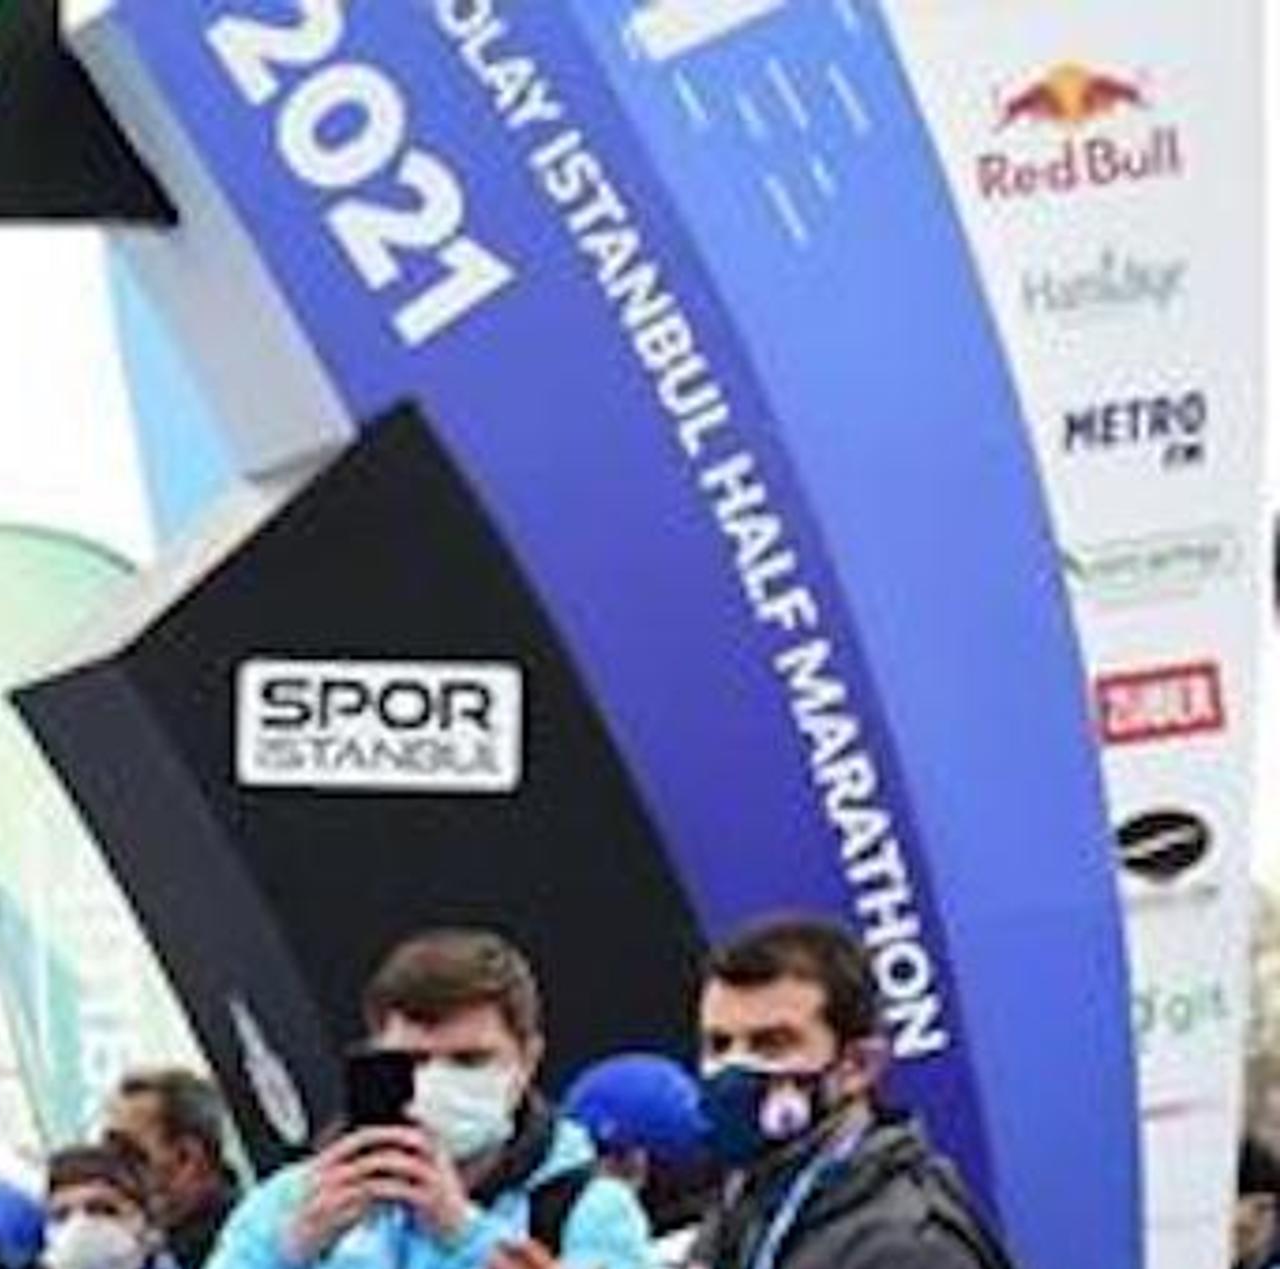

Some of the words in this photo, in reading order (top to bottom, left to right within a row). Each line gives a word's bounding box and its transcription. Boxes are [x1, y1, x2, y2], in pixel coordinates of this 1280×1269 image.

[205, 0, 517, 347] 2021
[977, 142, 1079, 200] Red
[1088, 128, 1182, 186] Bull
[1064, 389, 1208, 450] METRO
[433, 0, 561, 129] OLAY
[530, 130, 730, 456] ISTANBUL
[700, 452, 818, 632] HALF
[775, 636, 947, 1059] MARATHON
[260, 677, 492, 731] SPOR
